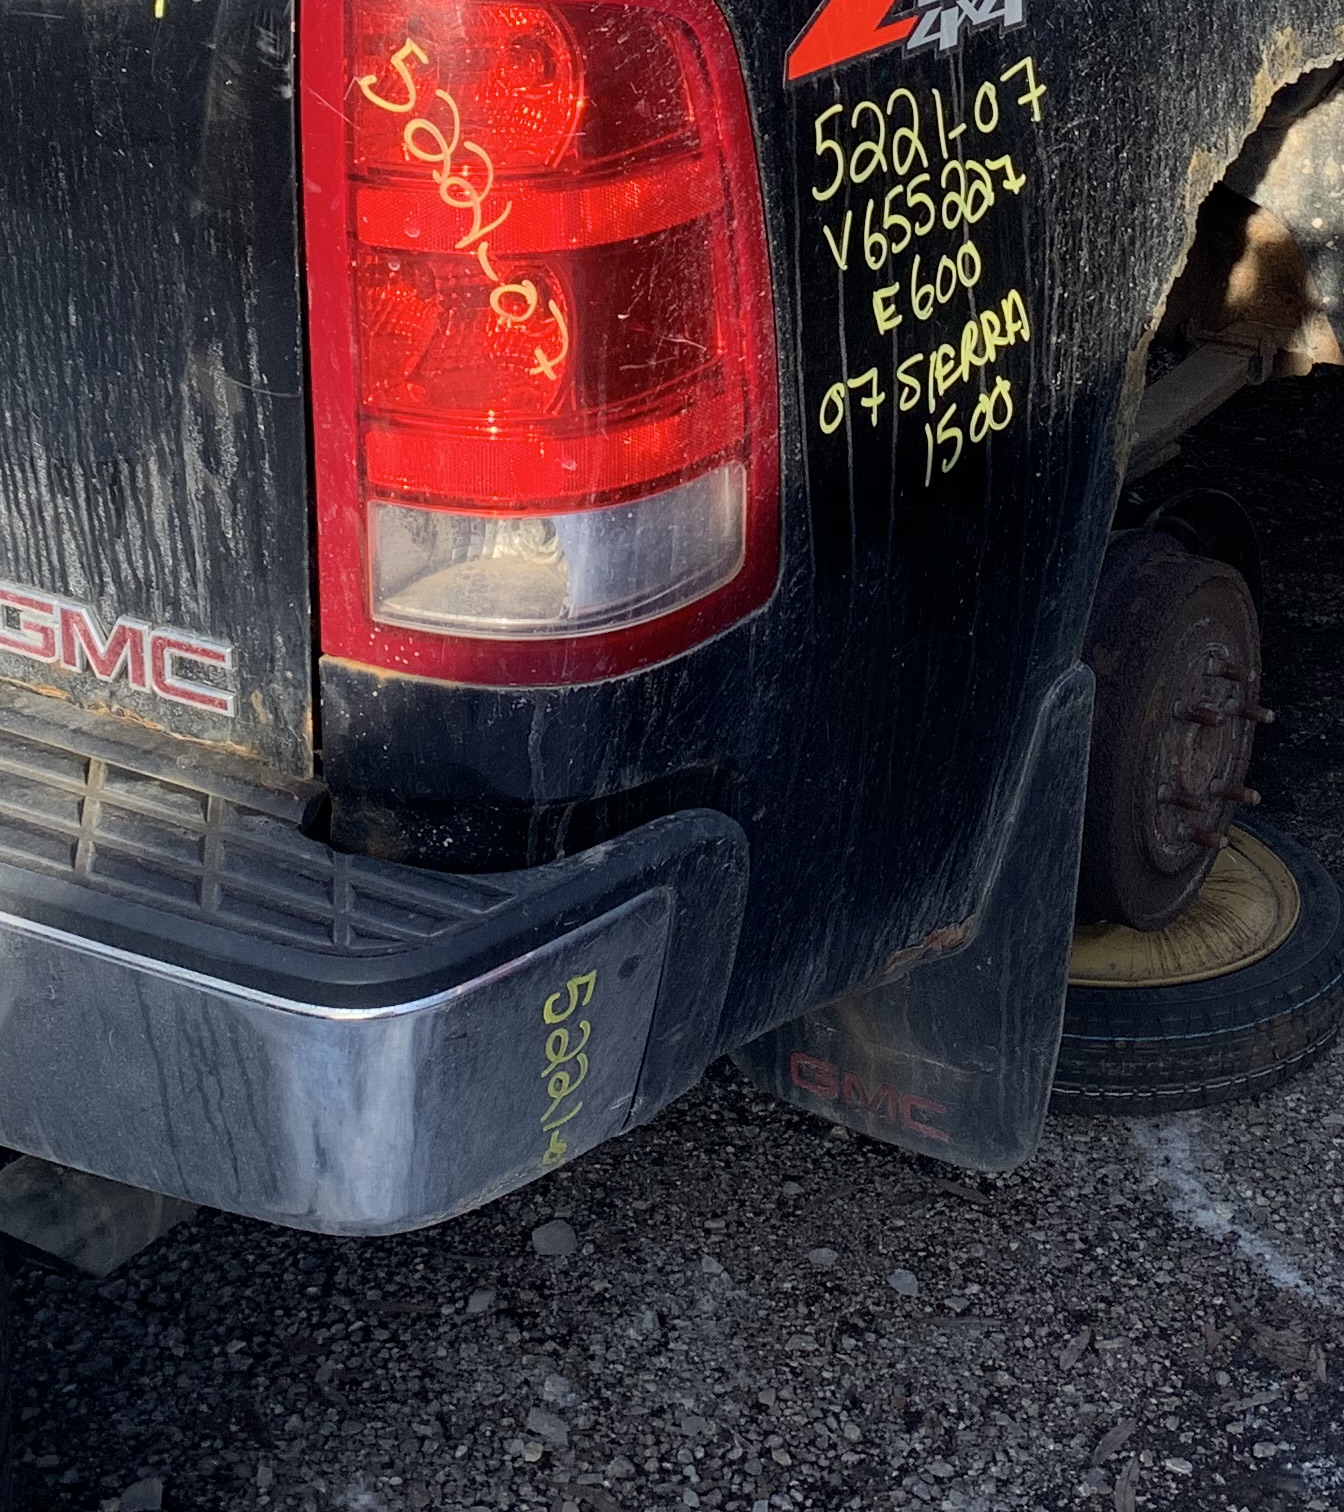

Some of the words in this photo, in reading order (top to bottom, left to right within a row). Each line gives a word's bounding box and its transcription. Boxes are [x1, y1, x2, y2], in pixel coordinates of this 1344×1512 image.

[811, 58, 1048, 202] 5221-07
[359, 37, 569, 380] 5221-07
[820, 373, 886, 435] 07
[897, 289, 1030, 415] SIERRA
[925, 376, 1014, 488] 1500
[790, 1051, 950, 1142] GMC
